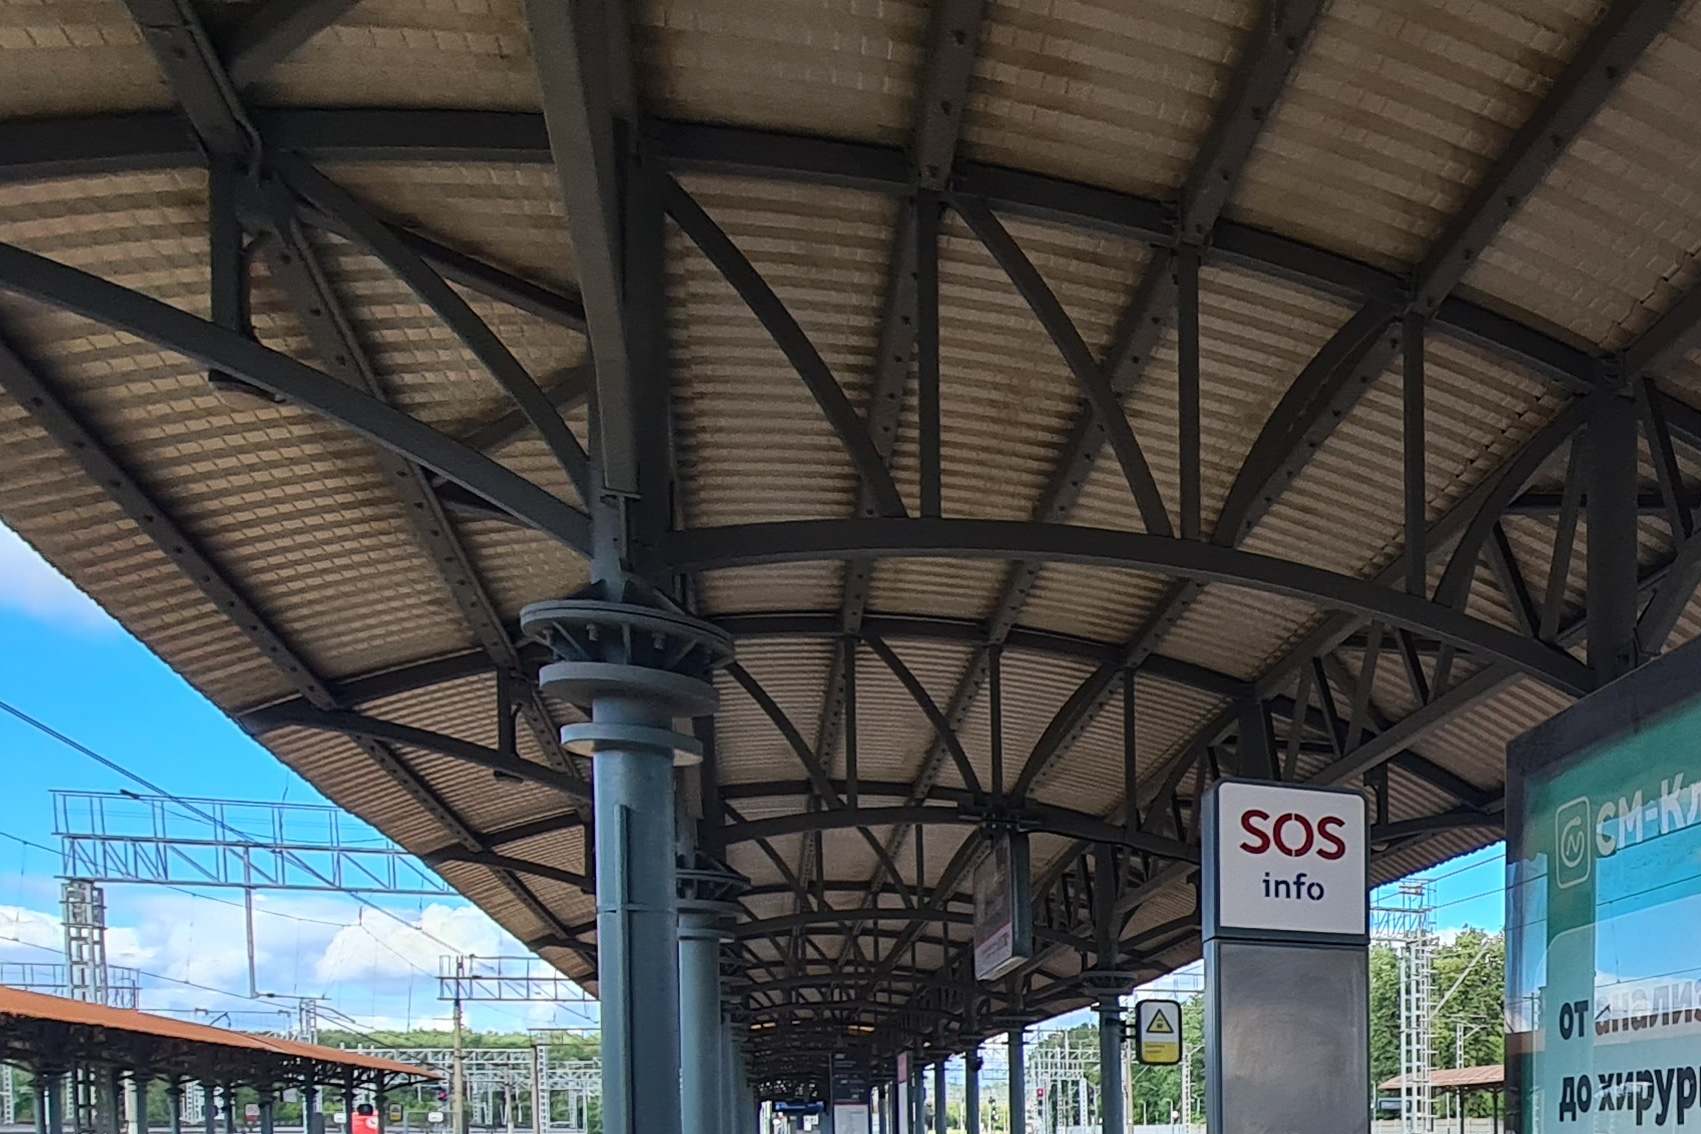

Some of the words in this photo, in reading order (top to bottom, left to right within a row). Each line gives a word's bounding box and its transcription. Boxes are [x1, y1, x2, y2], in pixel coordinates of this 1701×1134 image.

[1239, 808, 1346, 861] SOS
[1262, 872, 1325, 901] info
[1559, 1000, 1589, 1041] от
[1559, 1074, 1593, 1122] до
